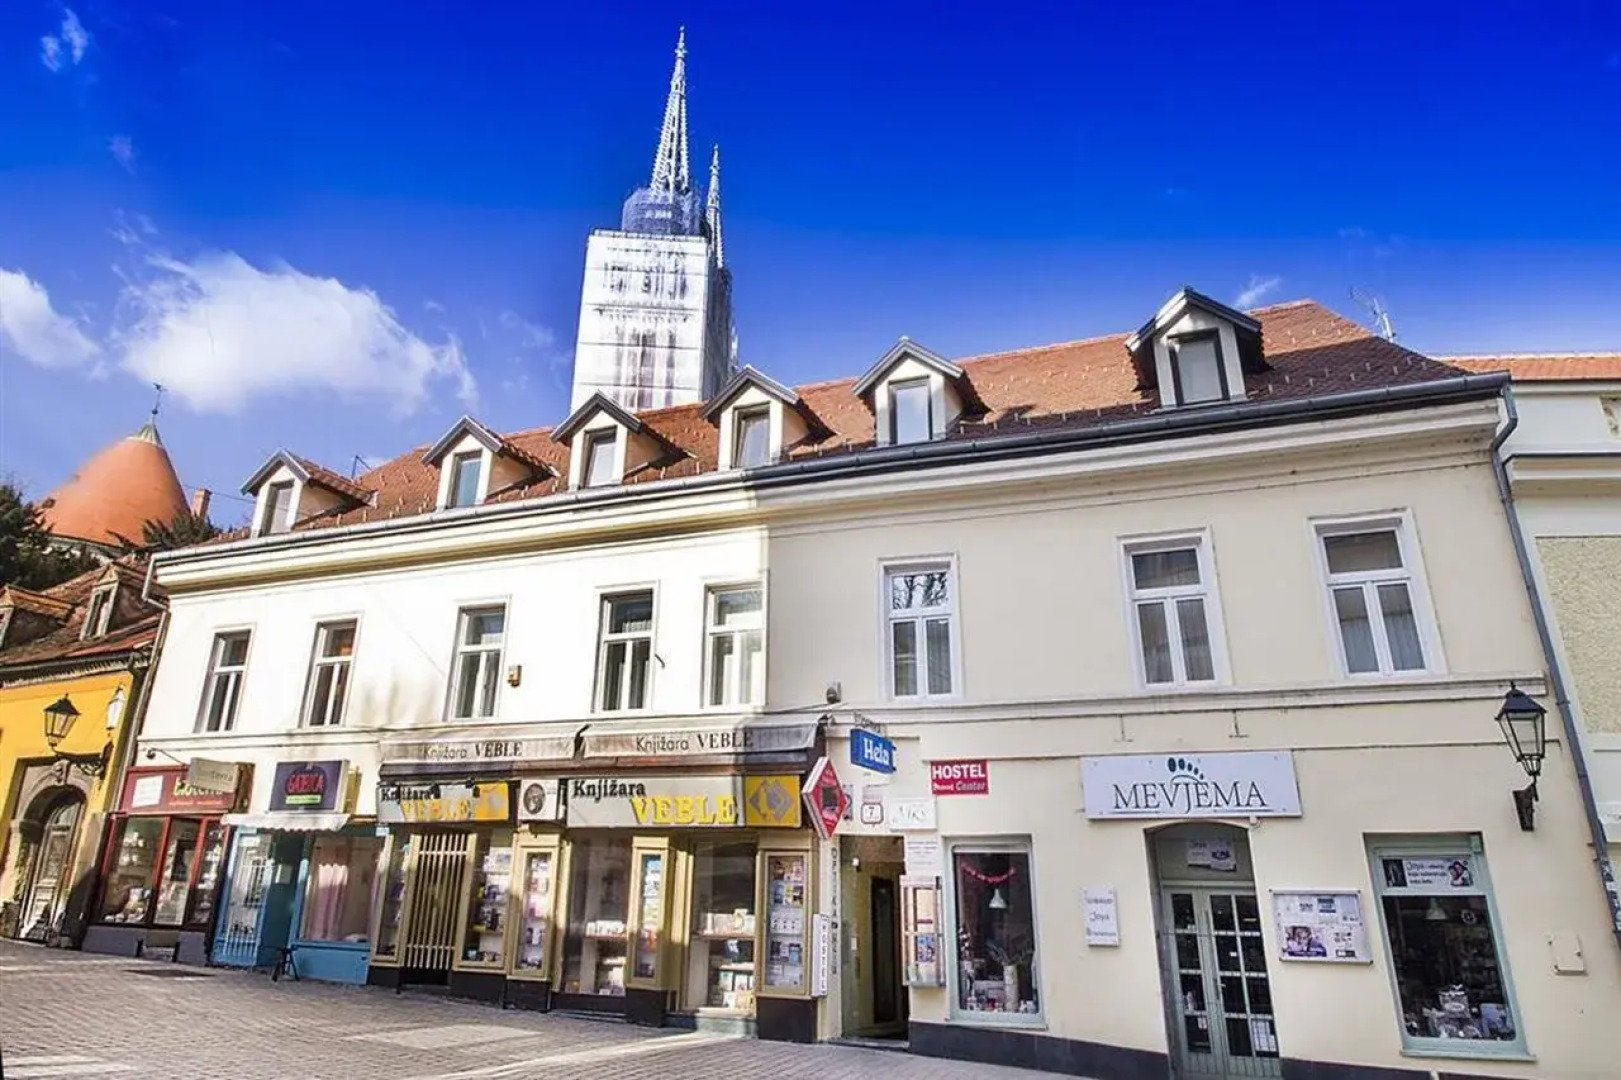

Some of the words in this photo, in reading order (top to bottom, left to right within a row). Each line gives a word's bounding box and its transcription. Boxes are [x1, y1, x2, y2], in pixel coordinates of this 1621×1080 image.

[474, 740, 523, 758] VEBLE
[636, 736, 690, 754] Knjižara
[697, 731, 754, 749] VEBLE
[932, 764, 986, 779] HOSTEL
[380, 784, 432, 804] Knižara
[572, 779, 647, 803] Knjižara
[1112, 781, 1269, 814] MEVJEMA
[629, 795, 739, 825] VEBLE
